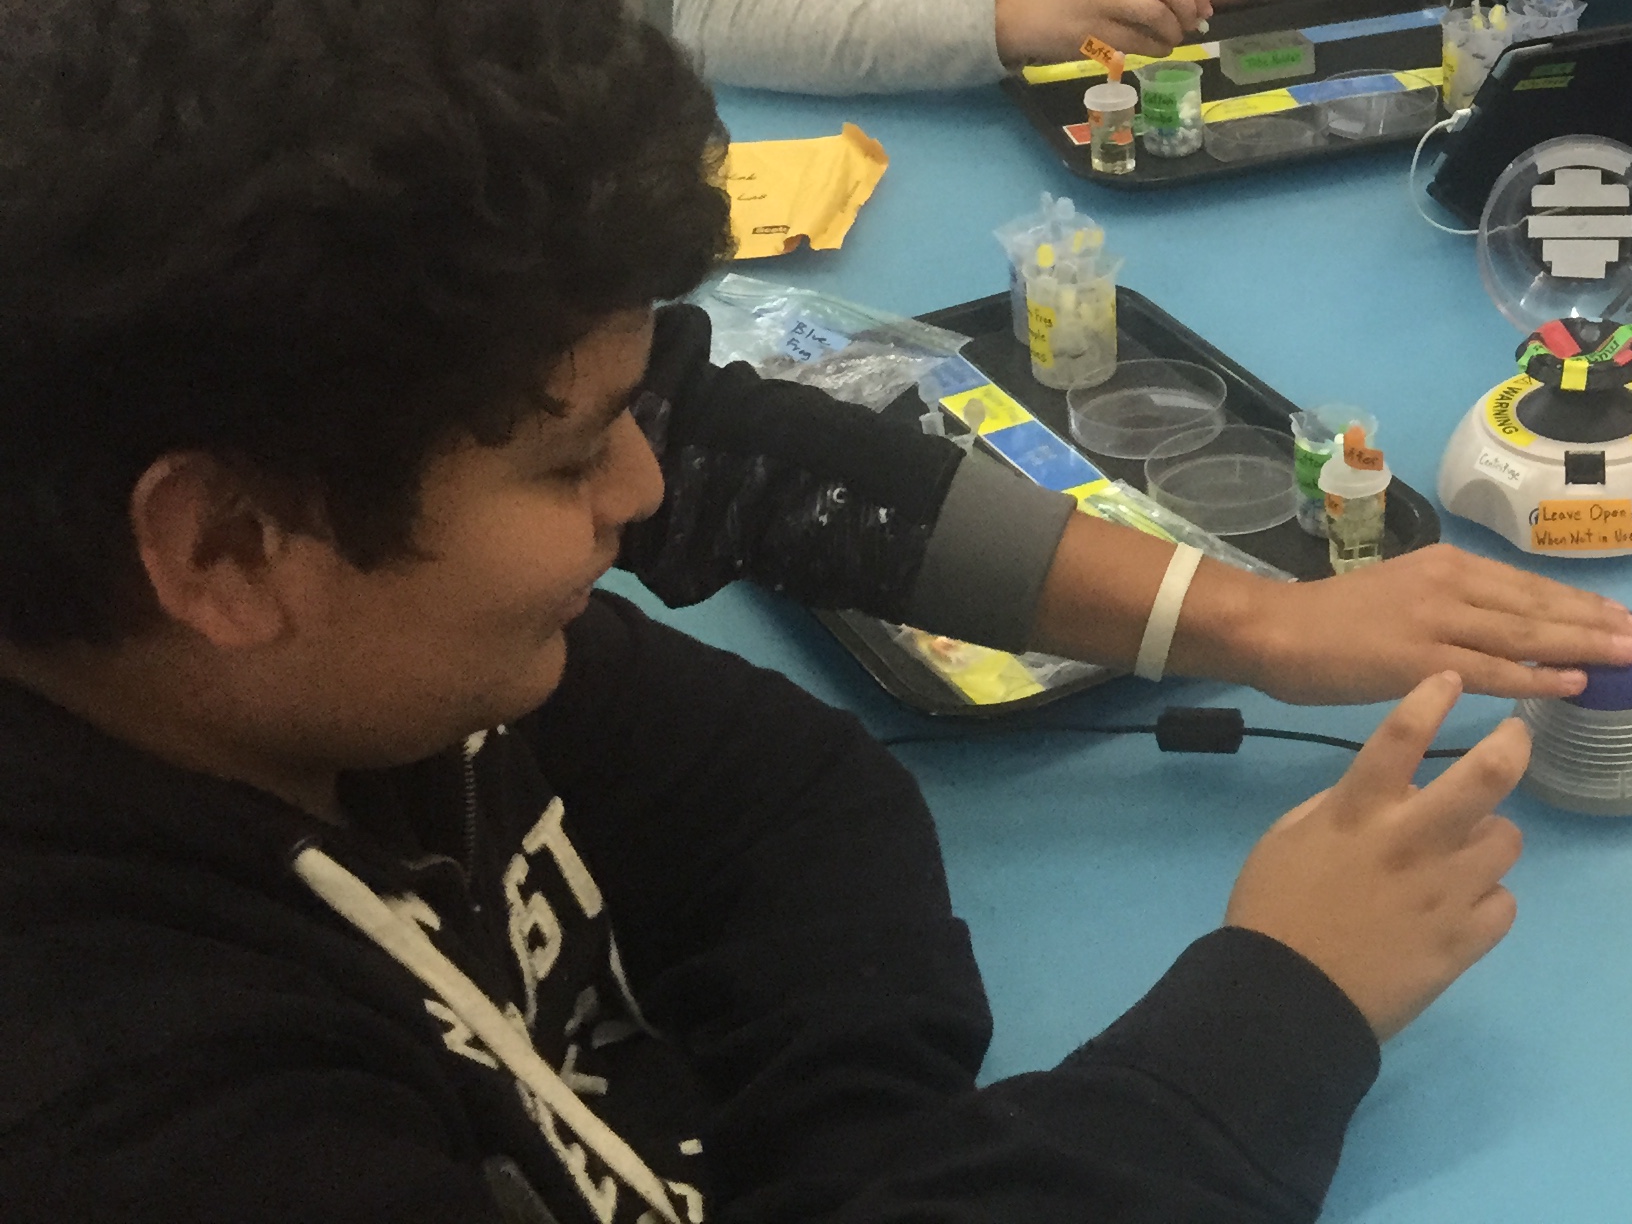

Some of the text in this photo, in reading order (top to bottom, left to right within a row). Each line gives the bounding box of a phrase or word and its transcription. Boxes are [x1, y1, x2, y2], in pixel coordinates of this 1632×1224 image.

[791, 320, 831, 346] Blue
[786, 337, 811, 361] Frog
[1493, 386, 1520, 435] WARNING
[1479, 452, 1520, 482] Centrifuge
[1542, 505, 1581, 522] Leave
[1589, 504, 1627, 524] Open
[1535, 531, 1567, 545] When
[1569, 529, 1593, 543] Not
[1598, 532, 1608, 543] in
